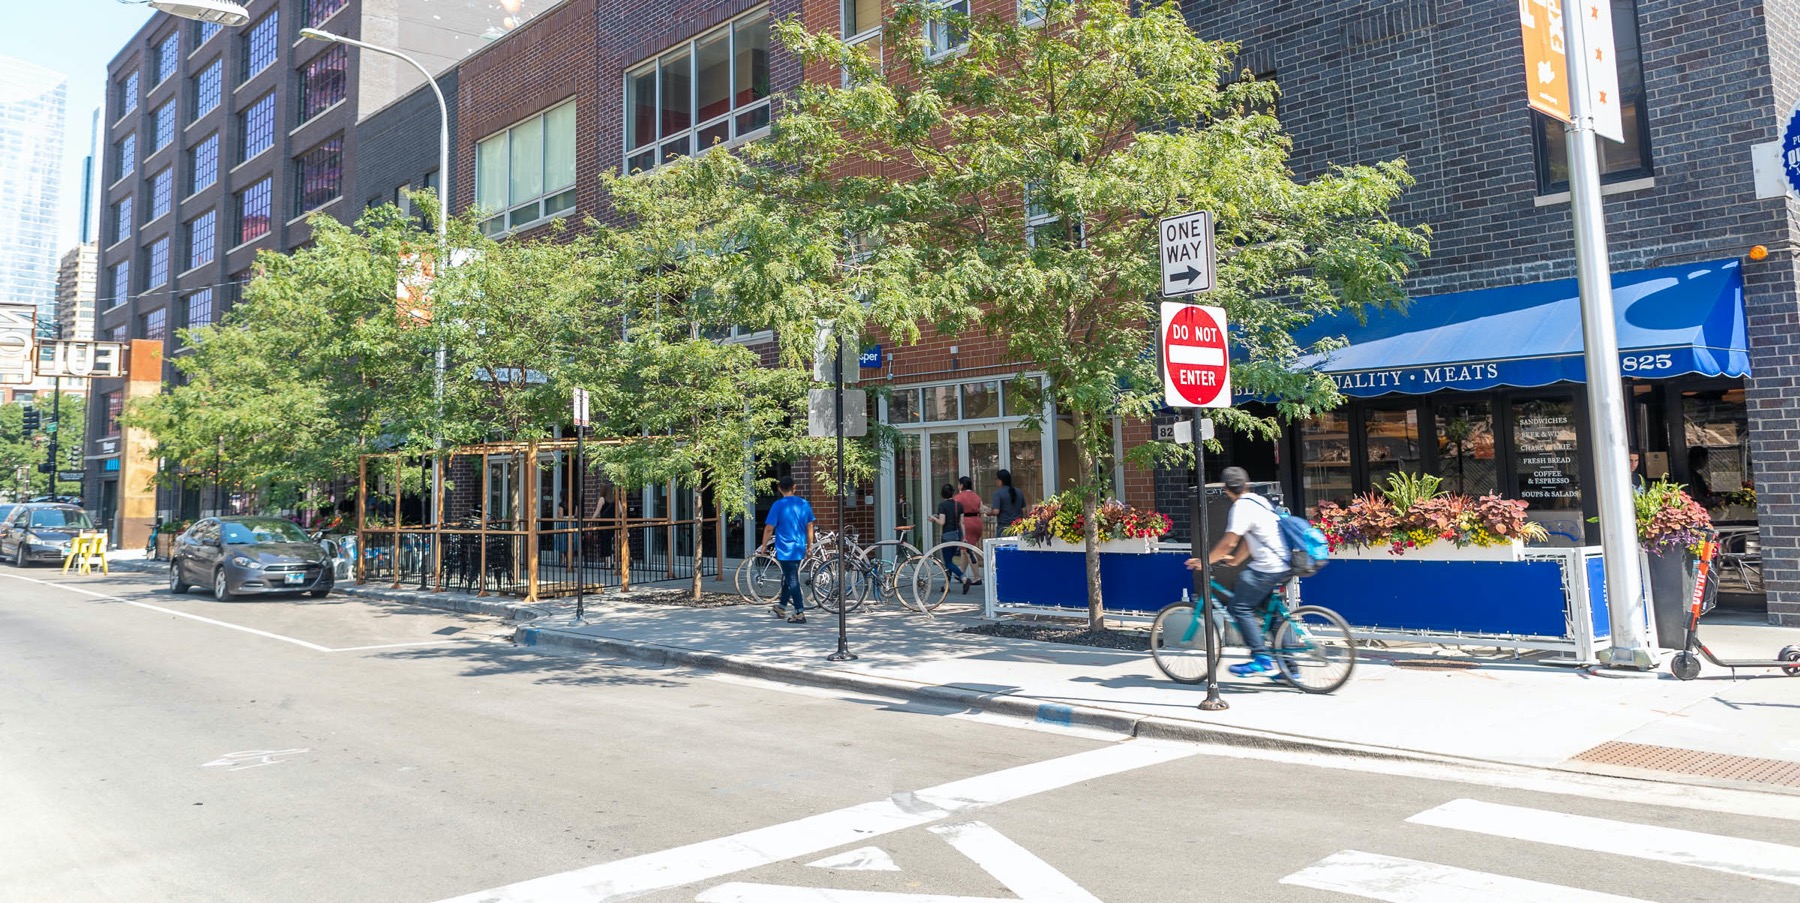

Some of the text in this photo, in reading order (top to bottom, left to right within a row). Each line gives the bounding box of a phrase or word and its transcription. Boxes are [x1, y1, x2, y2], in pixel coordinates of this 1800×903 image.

[1166, 219, 1201, 242] ONE
[1166, 240, 1202, 264] WAY
[1172, 323, 1217, 343] DO NOT
[860, 353, 878, 364] sper
[1622, 353, 1673, 372] 825
[1180, 369, 1216, 386] ENTER
[1331, 363, 1499, 389] UALITY MEATS
[1519, 417, 1568, 426] SANDWICHES
[1160, 427, 1174, 437] 82
[1521, 431, 1541, 439] BEER
[1547, 456, 1571, 464] BREAD
[1534, 477, 1570, 485] ESPRESSO
[1551, 490, 1579, 498] SALADS
